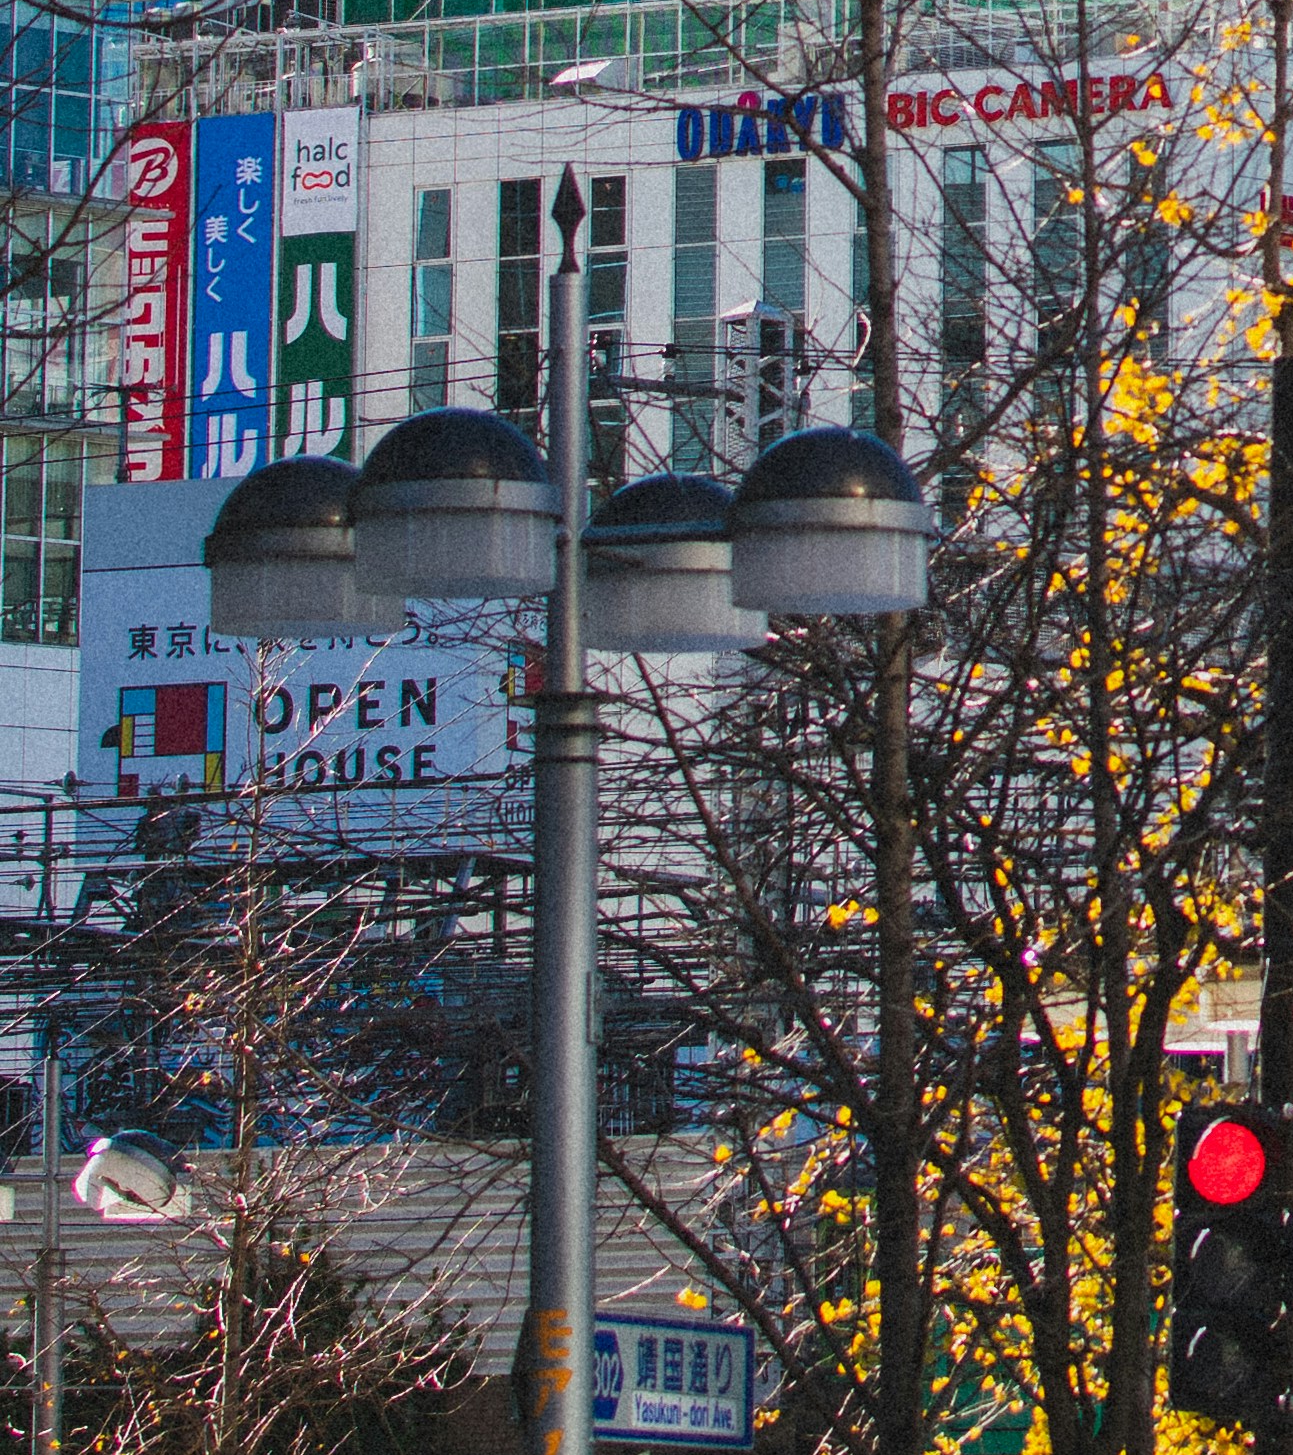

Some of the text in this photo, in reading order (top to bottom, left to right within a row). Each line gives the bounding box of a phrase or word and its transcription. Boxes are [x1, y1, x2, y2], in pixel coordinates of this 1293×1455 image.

[677, 92, 845, 161] ODAKYU
[886, 72, 1173, 129] BIC CAMERA
[291, 162, 350, 191] food
[297, 136, 348, 163] halc
[236, 156, 263, 244] 楽しく
[205, 215, 229, 303] 美しく
[255, 676, 437, 735] OPEN
[261, 744, 437, 787] HOUSE
[637, 1333, 733, 1395] 靖国通り
